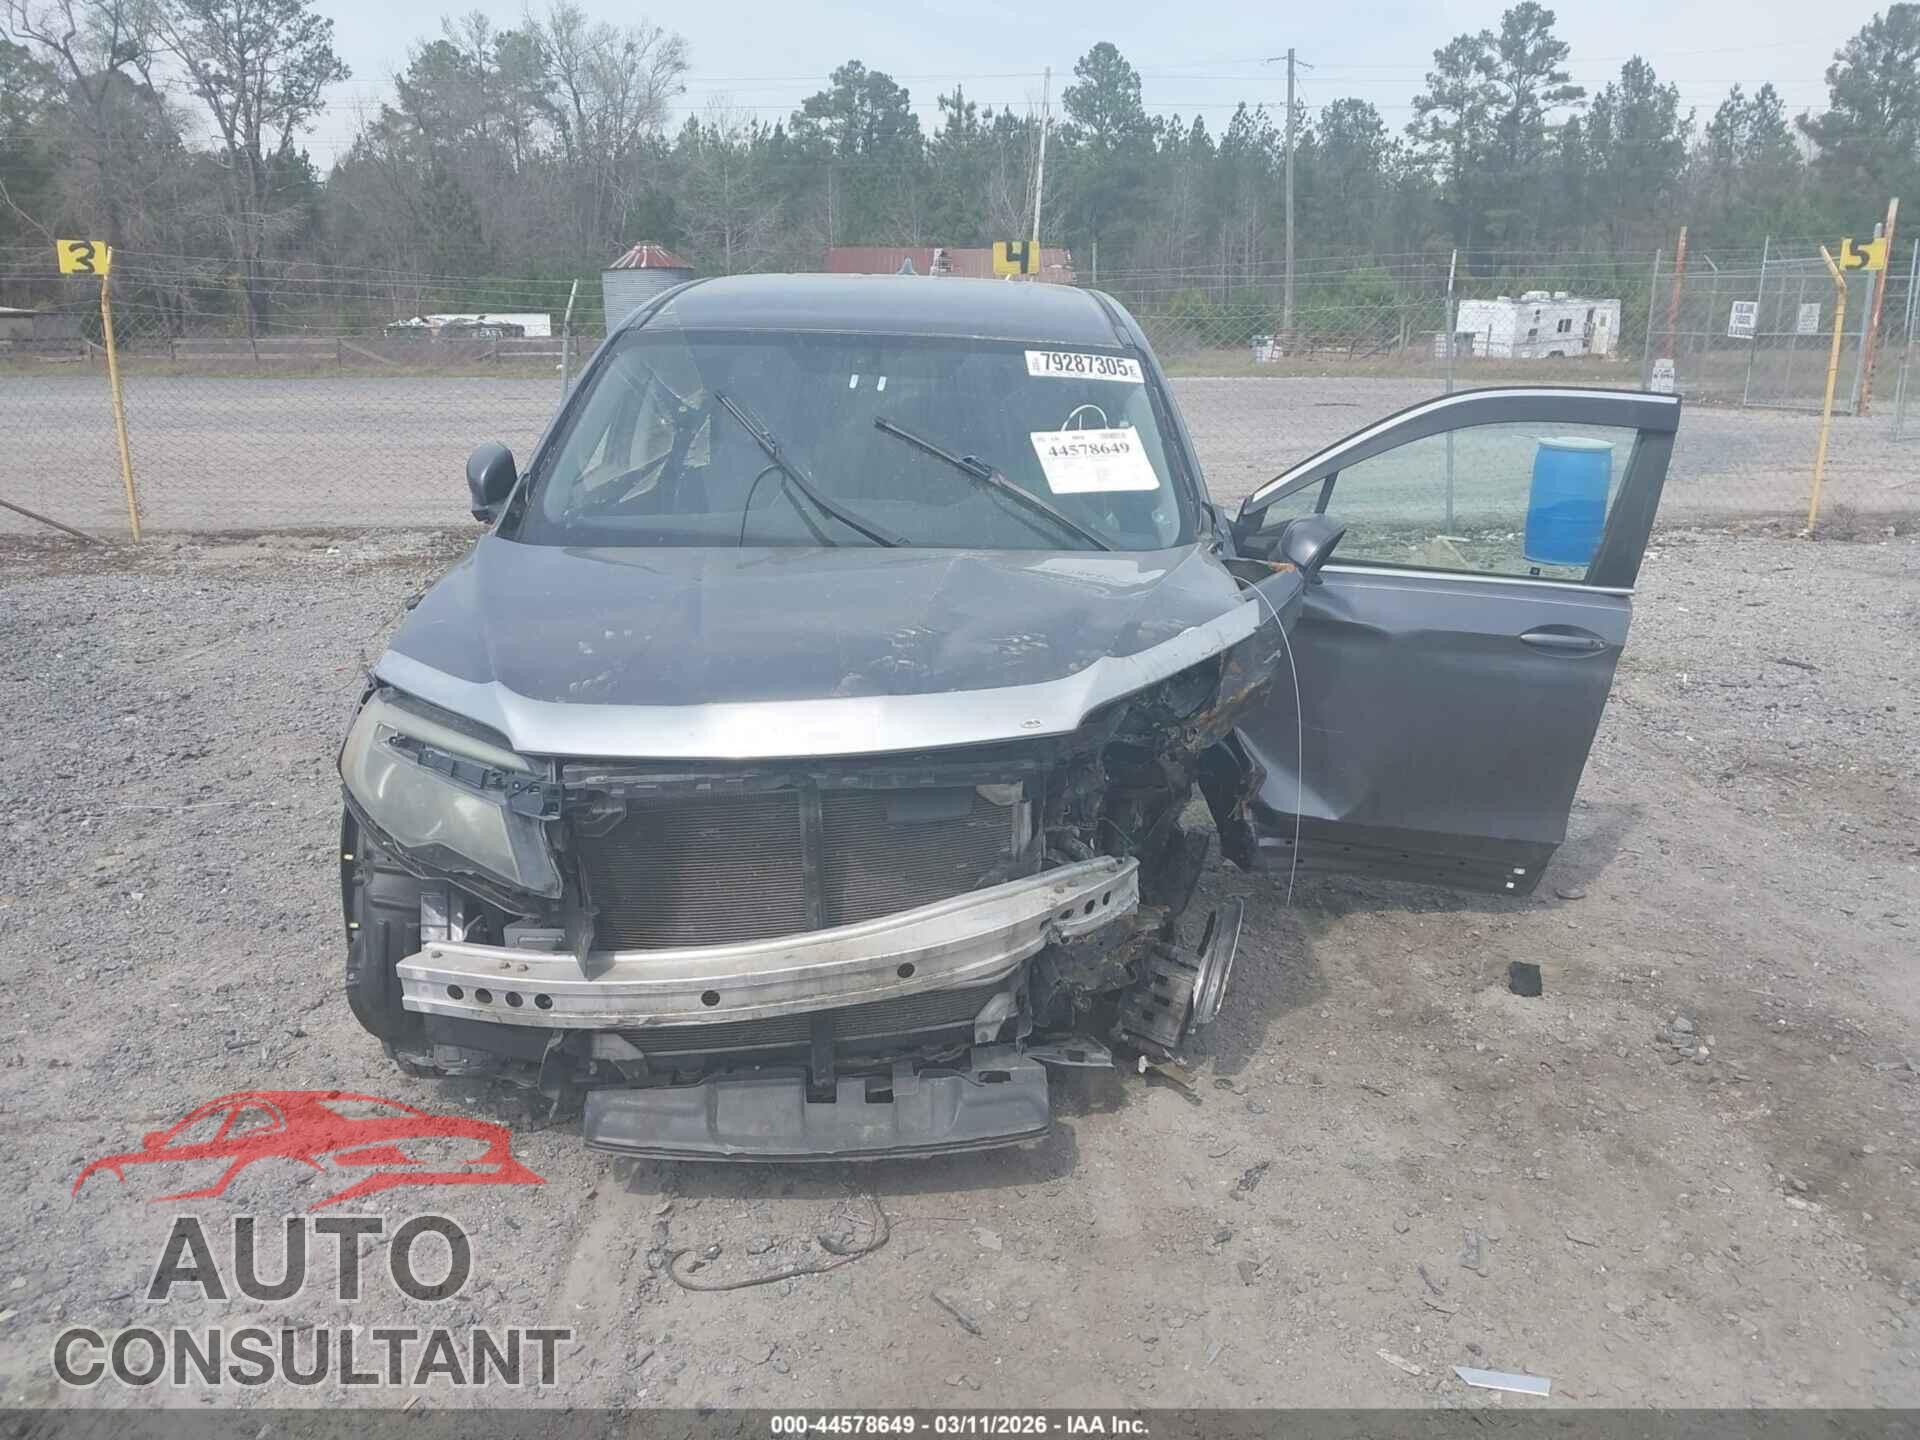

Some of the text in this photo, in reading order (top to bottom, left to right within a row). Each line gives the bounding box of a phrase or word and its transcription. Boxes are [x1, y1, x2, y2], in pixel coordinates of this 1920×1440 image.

[69, 241, 96, 273] 3
[1006, 240, 1029, 273] 4
[1845, 238, 1872, 269] 5
[1048, 442, 1130, 457] 44578649
